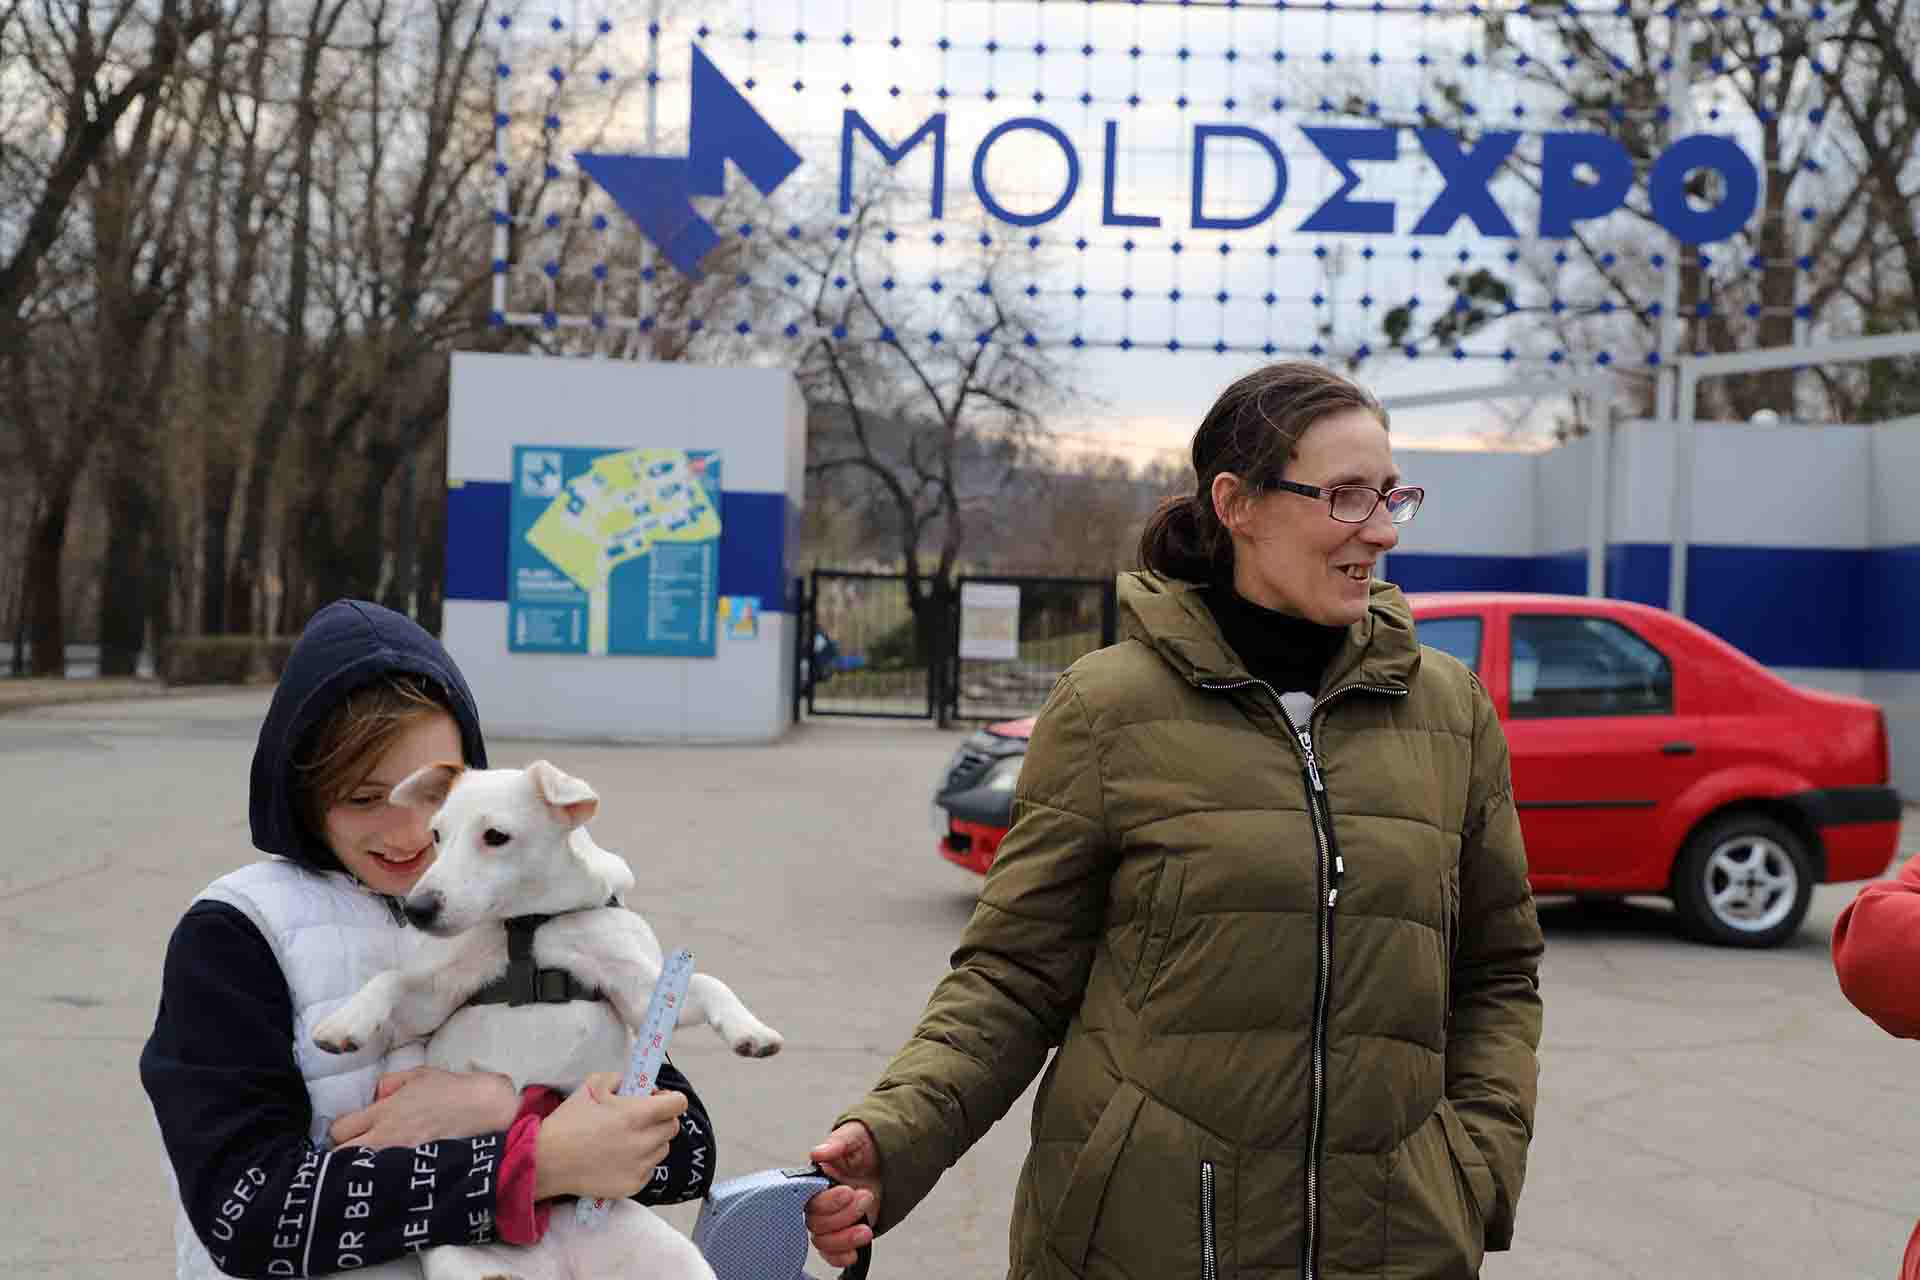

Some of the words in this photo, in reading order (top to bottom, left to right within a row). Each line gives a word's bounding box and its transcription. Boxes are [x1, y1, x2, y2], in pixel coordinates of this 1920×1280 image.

[838, 107, 1761, 245] MOLDEXPO
[344, 1180, 374, 1220] BE
[407, 1143, 439, 1213] LIFE
[465, 1135, 497, 1199] LIFE
[211, 1167, 267, 1241] USED
[337, 1231, 366, 1270] OR
